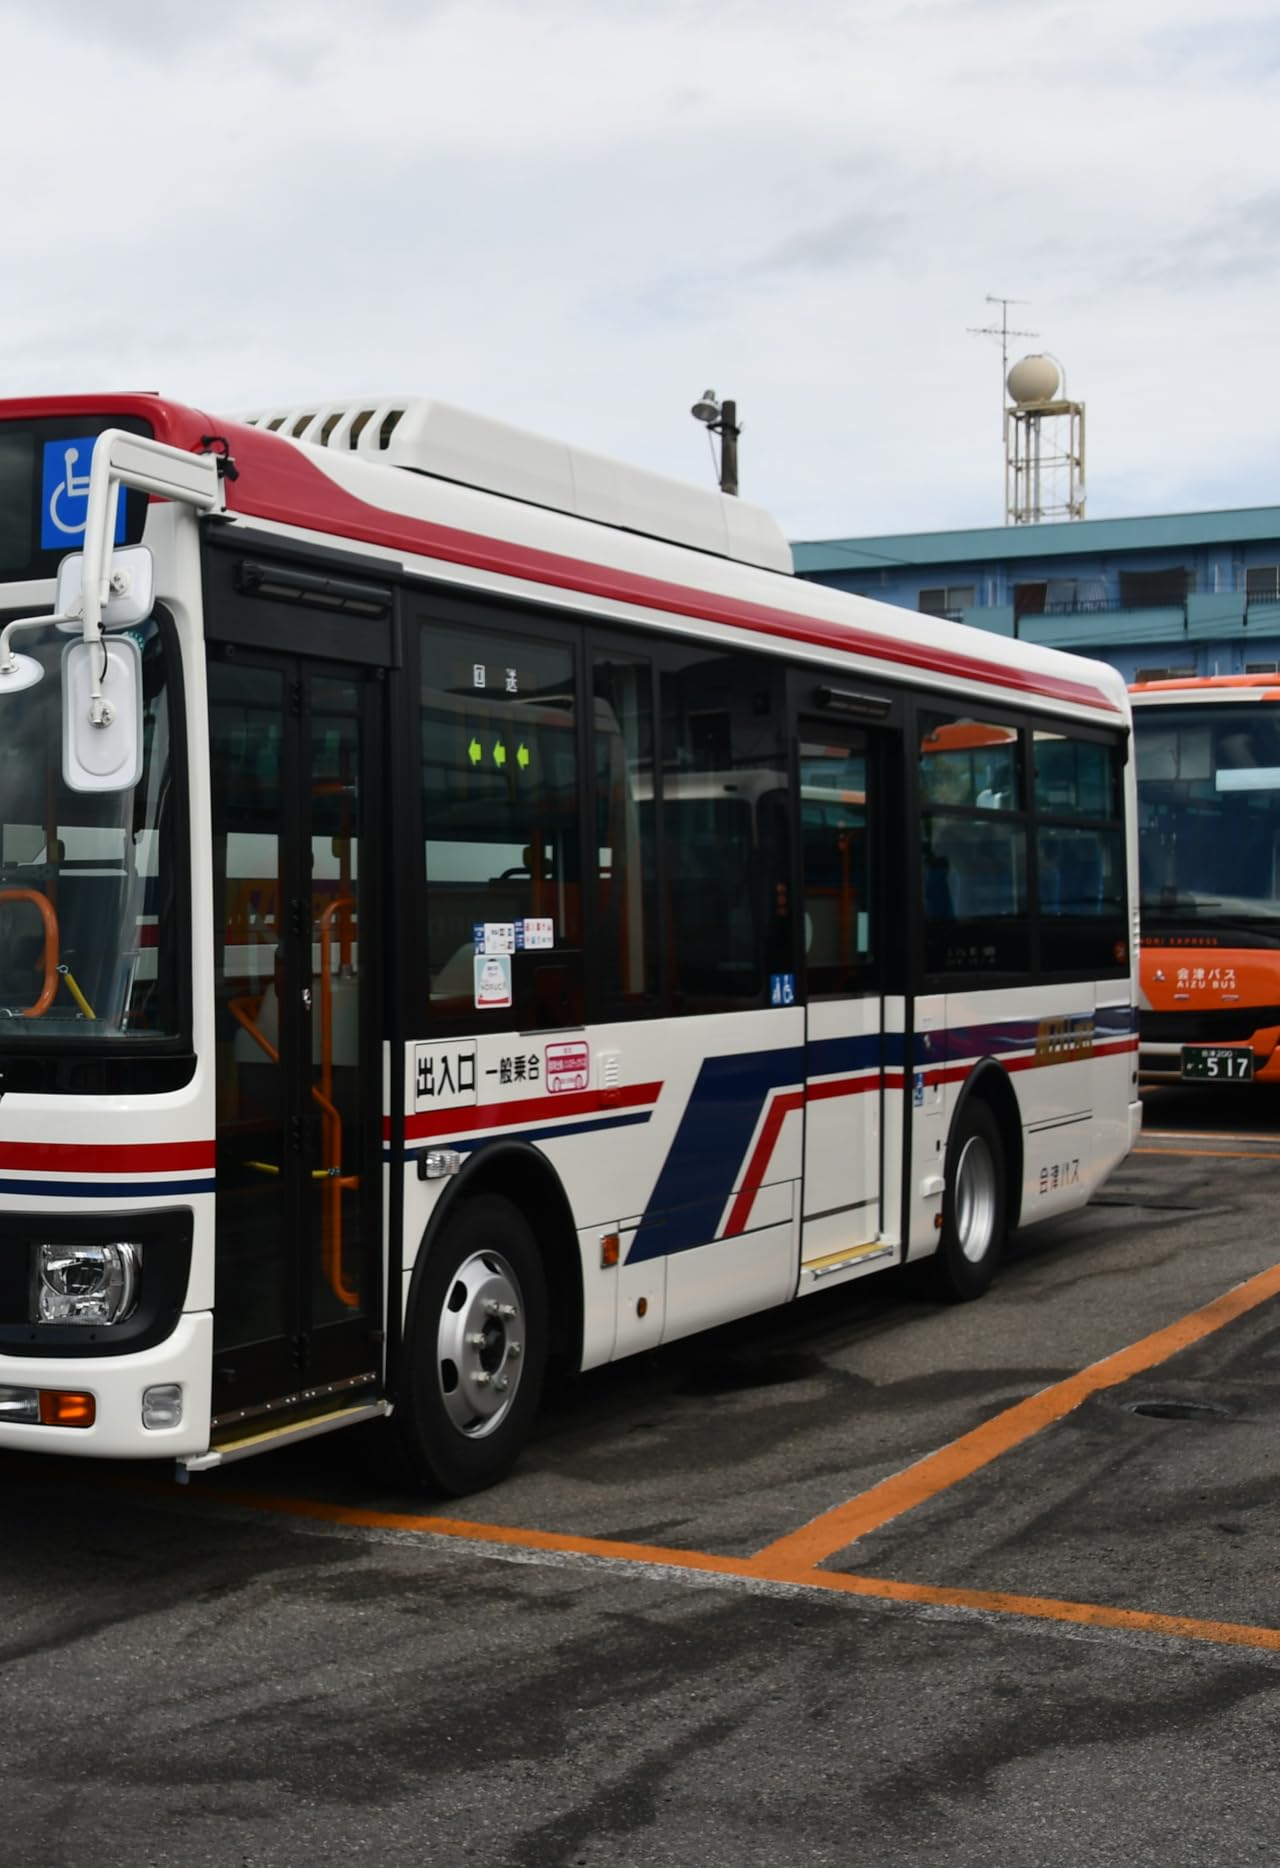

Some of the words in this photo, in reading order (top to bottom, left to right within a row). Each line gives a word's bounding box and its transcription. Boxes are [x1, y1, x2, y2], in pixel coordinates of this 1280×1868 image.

[1176, 980, 1206, 989] AIZU
[1211, 980, 1236, 989] BUS
[417, 1053, 475, 1098] 出入口
[485, 1054, 540, 1084] 一般乗合
